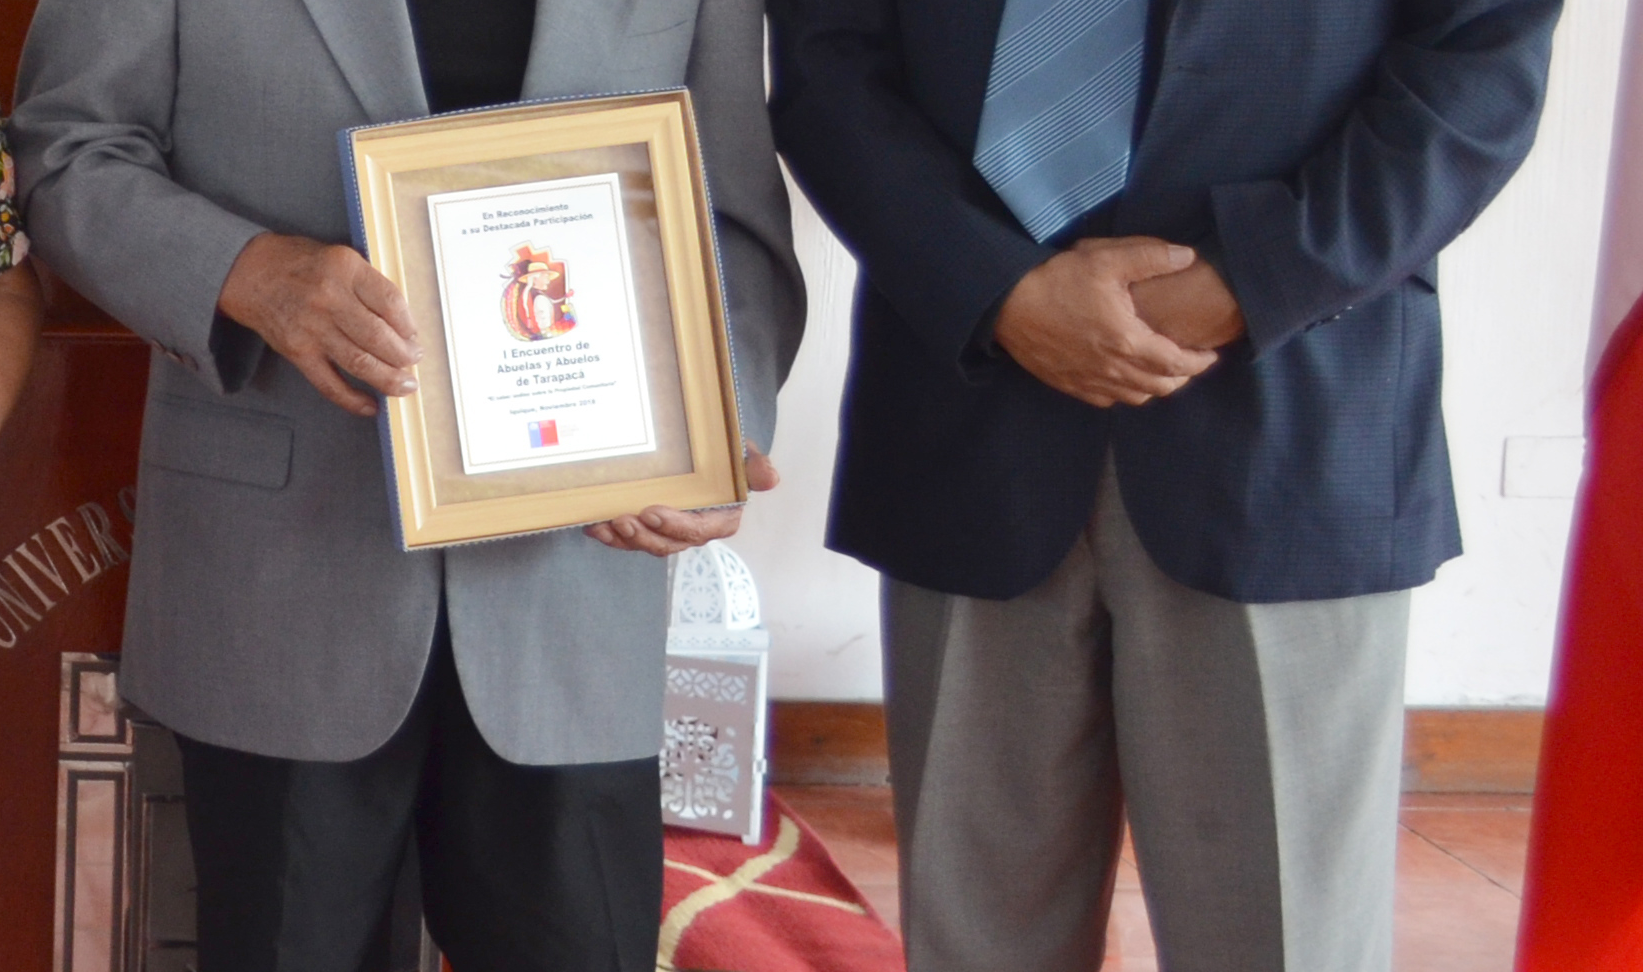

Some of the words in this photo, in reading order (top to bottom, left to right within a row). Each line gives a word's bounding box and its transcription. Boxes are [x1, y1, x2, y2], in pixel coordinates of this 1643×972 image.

[483, 212, 493, 220] En
[496, 203, 568, 218] Reconocimiento
[470, 226, 480, 234] su
[483, 221, 530, 232] Destacada
[534, 212, 593, 225] Participación
[503, 350, 507, 359] I
[512, 344, 571, 358] Encuentro
[576, 342, 589, 350] de
[497, 362, 541, 373] Abuelas
[545, 361, 552, 370] y
[556, 354, 600, 366] Abuelos
[516, 377, 529, 386] de
[533, 370, 585, 384] Tarapacá
